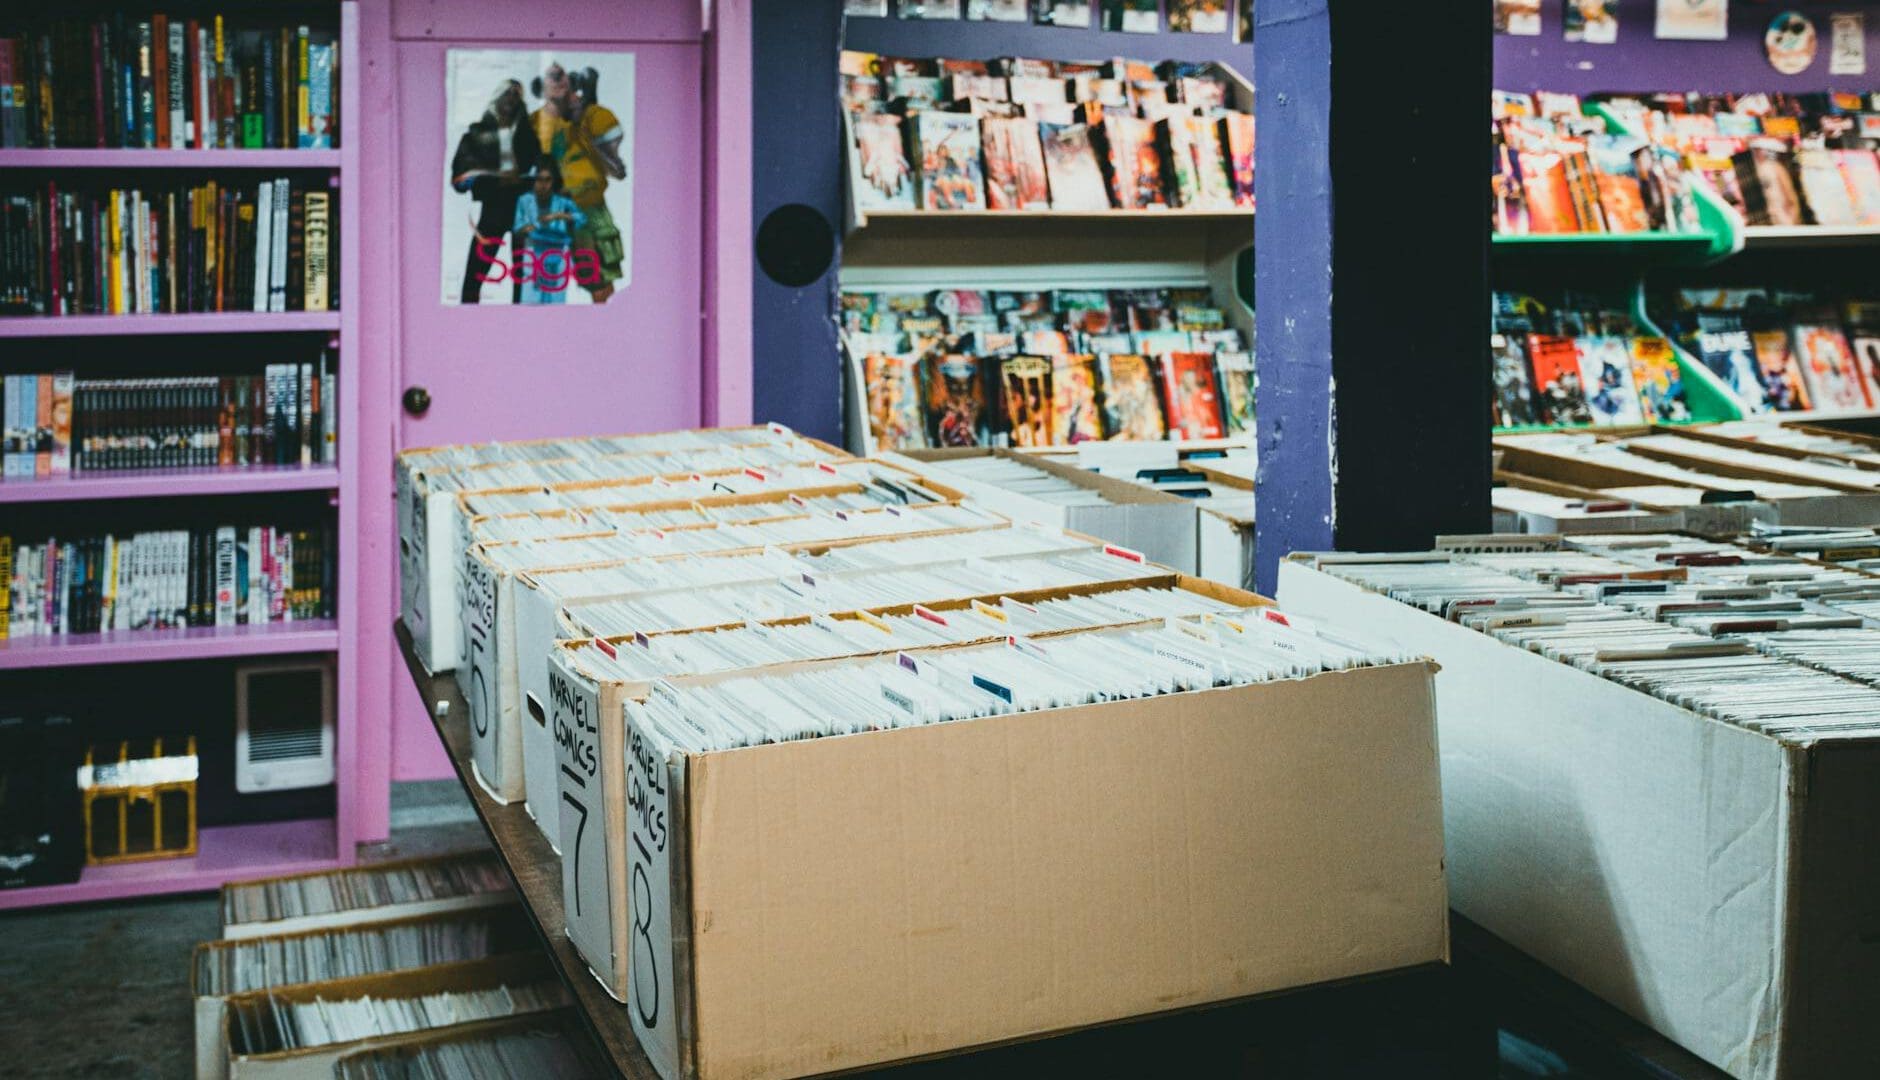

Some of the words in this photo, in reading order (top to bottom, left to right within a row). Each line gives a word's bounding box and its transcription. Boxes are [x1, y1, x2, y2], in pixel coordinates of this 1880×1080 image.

[474, 235, 602, 293] Saga
[549, 671, 597, 734] MARVEL
[552, 710, 598, 777] COMICS
[625, 723, 666, 796] MARVEL
[626, 763, 667, 853] COMICS
